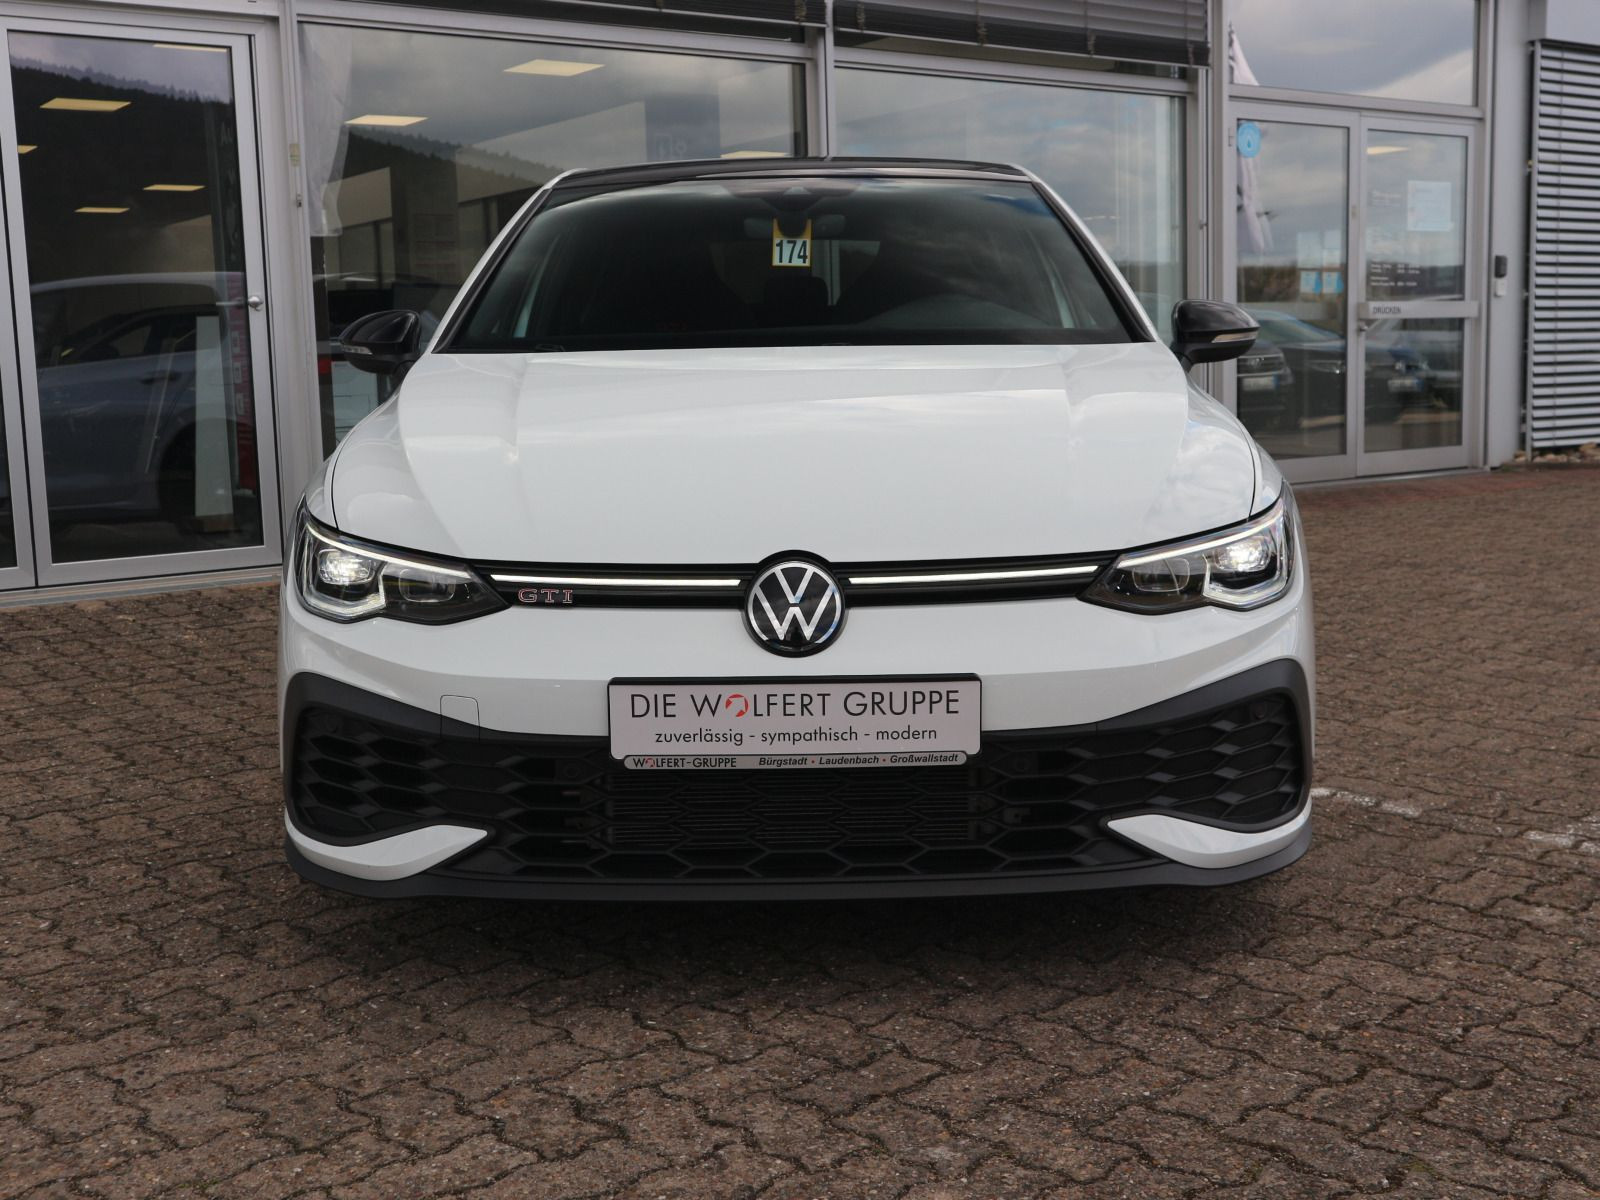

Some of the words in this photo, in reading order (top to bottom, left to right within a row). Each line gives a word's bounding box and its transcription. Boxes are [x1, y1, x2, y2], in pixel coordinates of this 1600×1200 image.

[775, 240, 808, 264] 174
[518, 588, 573, 604] GTI
[630, 693, 677, 718] DIE
[690, 692, 831, 718] WOLFERT
[843, 689, 960, 717] GRUPPE
[655, 727, 744, 747] zuverlässig
[761, 725, 858, 746] sympathisch
[876, 724, 937, 741] modern
[633, 757, 737, 768] WOLFERT-GRUPPE
[759, 757, 807, 767] Bürgstadt
[819, 755, 879, 765] Laudenbach
[890, 753, 959, 764] Großwallstadt
